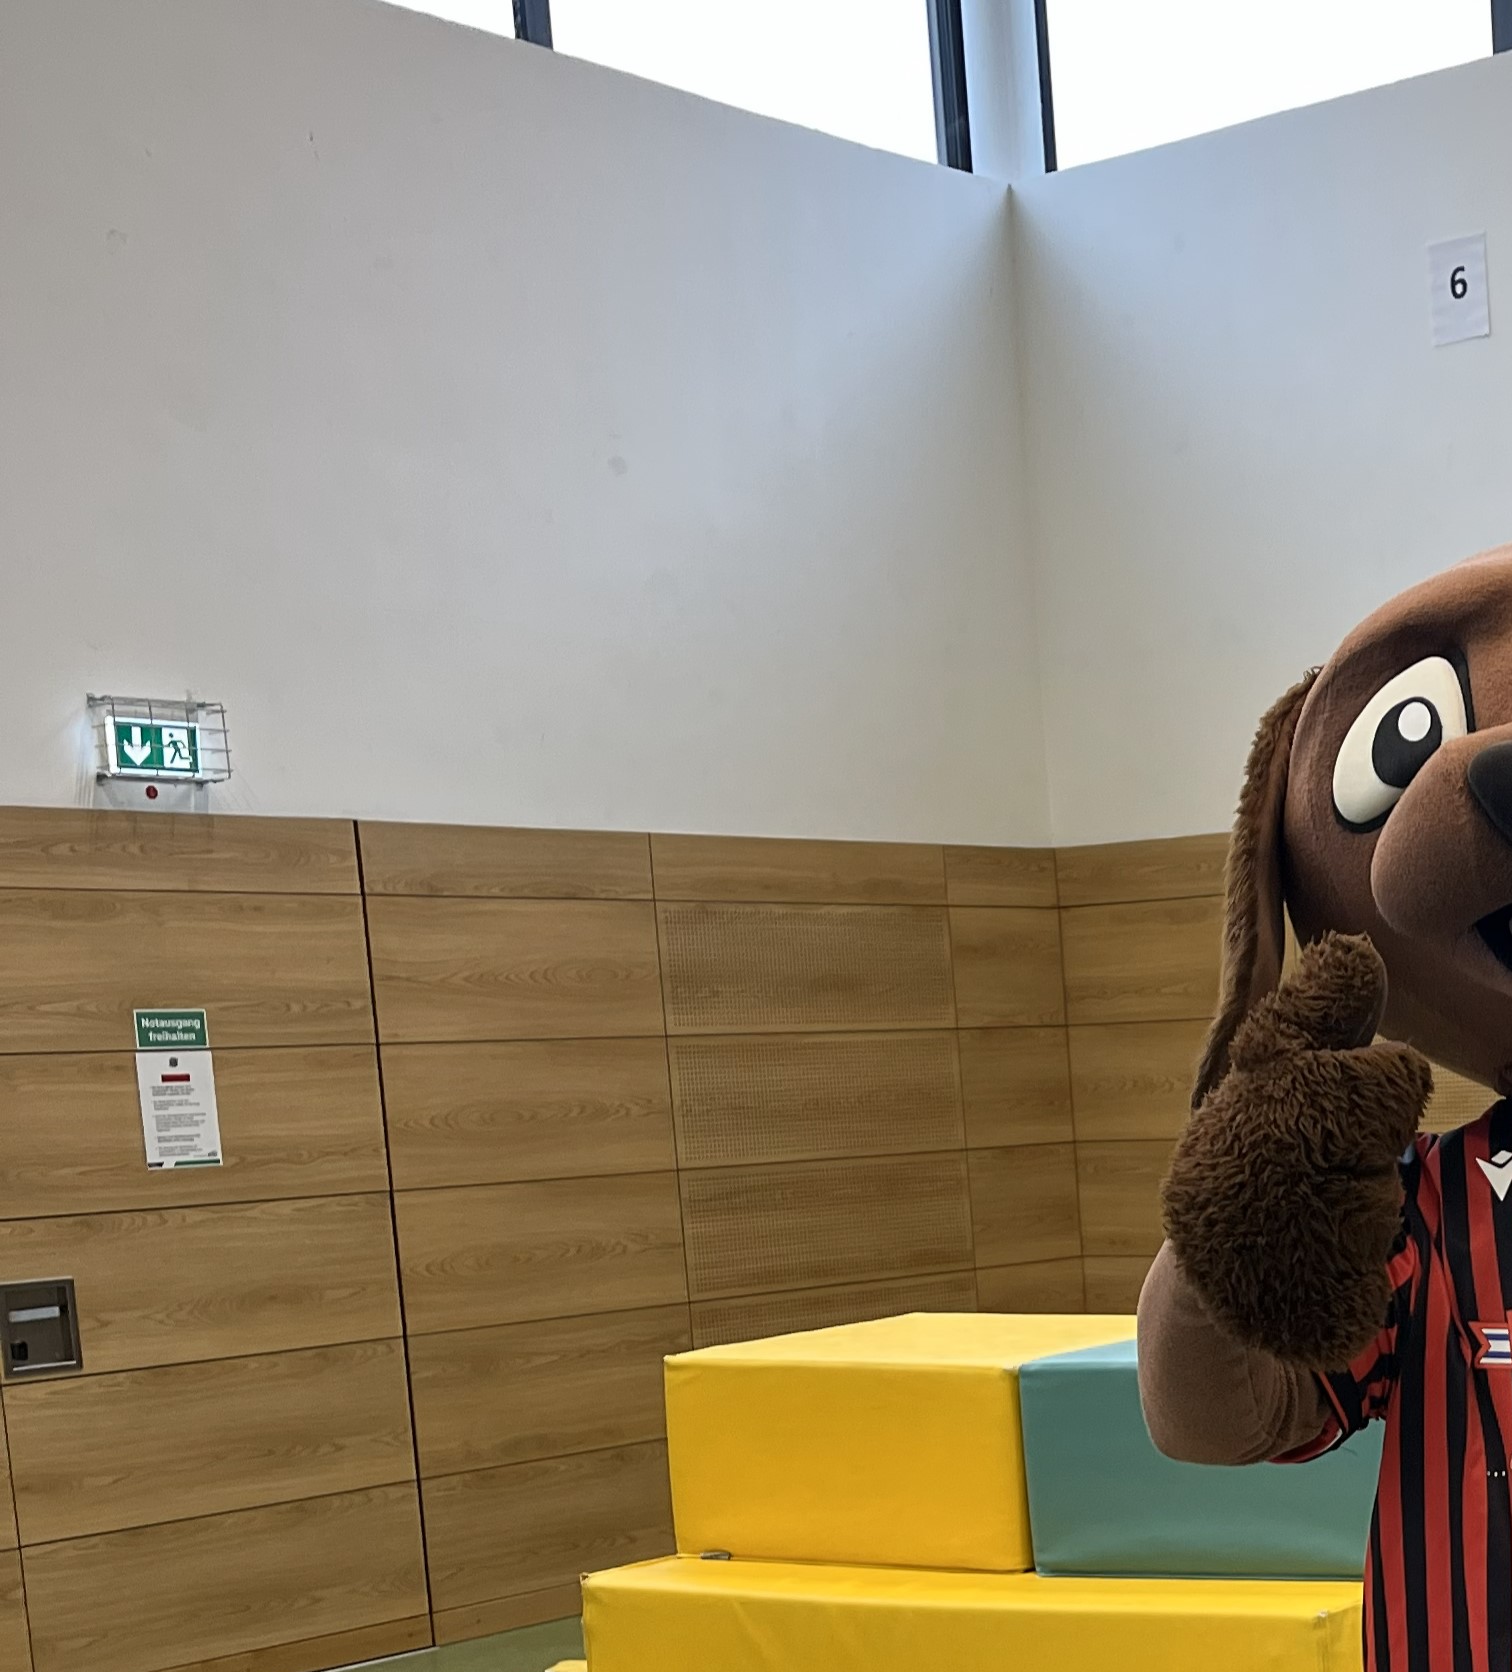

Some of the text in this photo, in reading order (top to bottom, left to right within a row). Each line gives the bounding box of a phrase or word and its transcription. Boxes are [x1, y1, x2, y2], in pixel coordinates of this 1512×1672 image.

[1450, 265, 1468, 300] 6
[141, 1017, 201, 1030] Notausgang
[148, 1030, 197, 1042] freihalten
